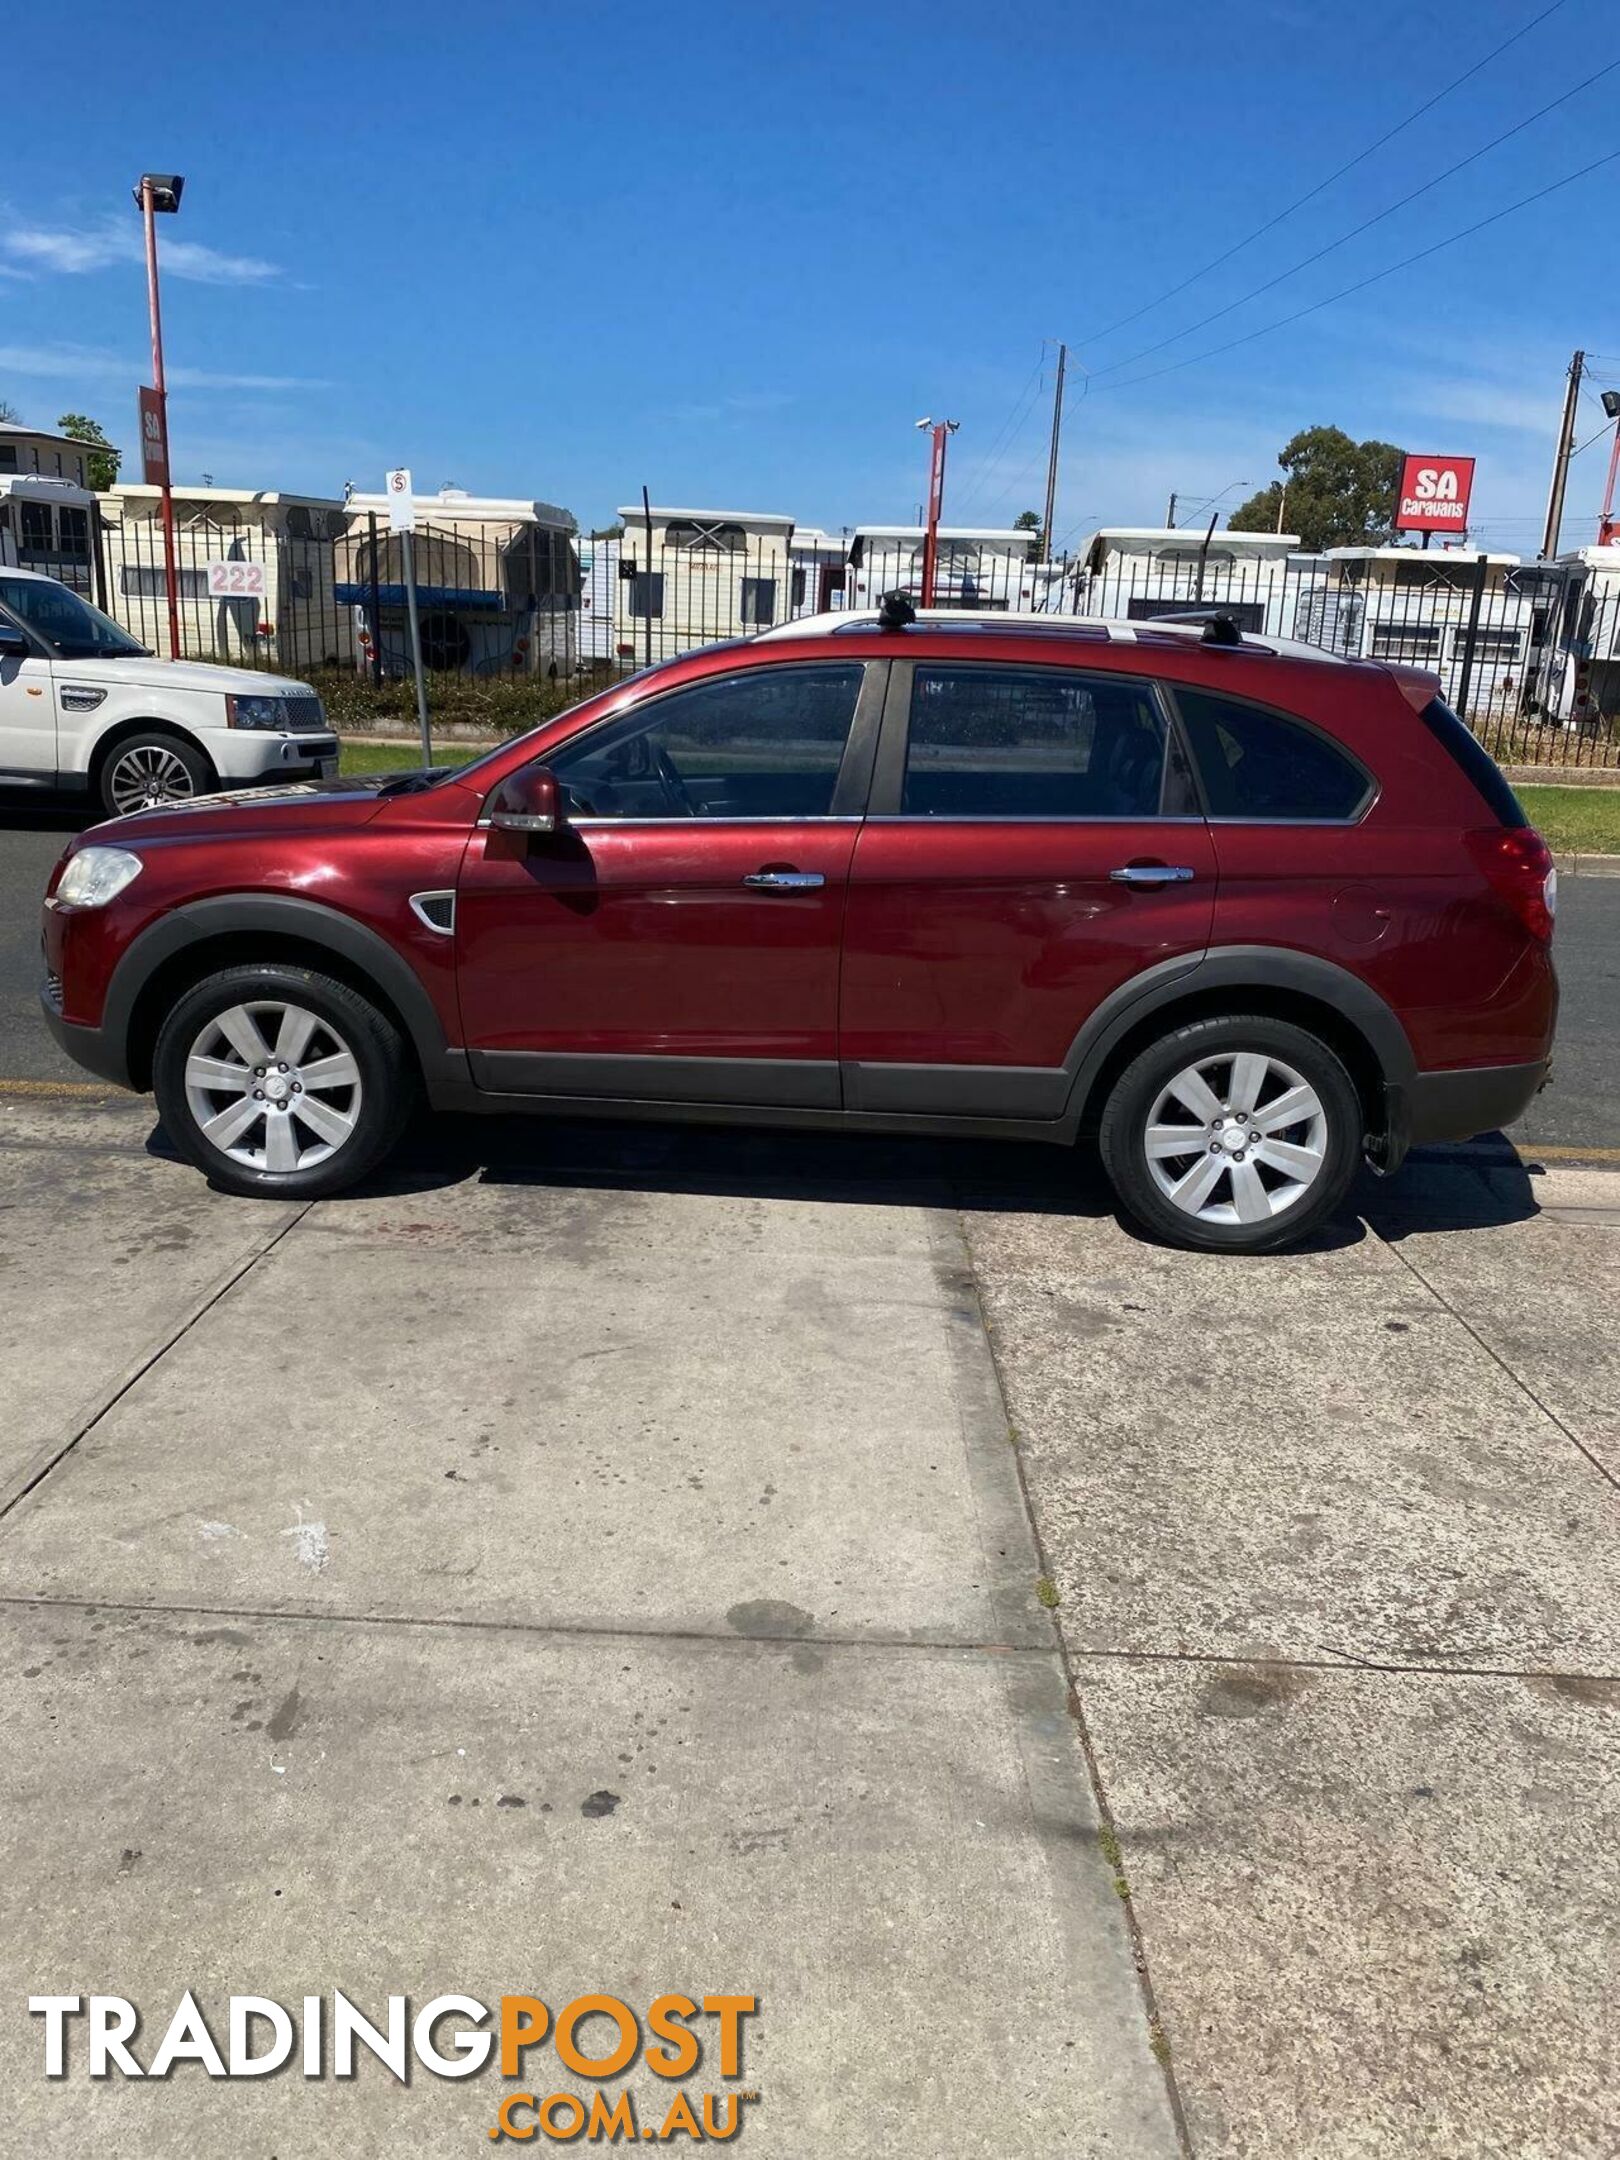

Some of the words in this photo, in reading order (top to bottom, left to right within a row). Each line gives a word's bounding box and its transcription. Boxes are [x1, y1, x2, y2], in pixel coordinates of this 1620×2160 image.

[144, 411, 160, 440] SA
[1415, 468, 1458, 500] SA
[1401, 498, 1464, 518] Caravans
[212, 564, 263, 593] 222
